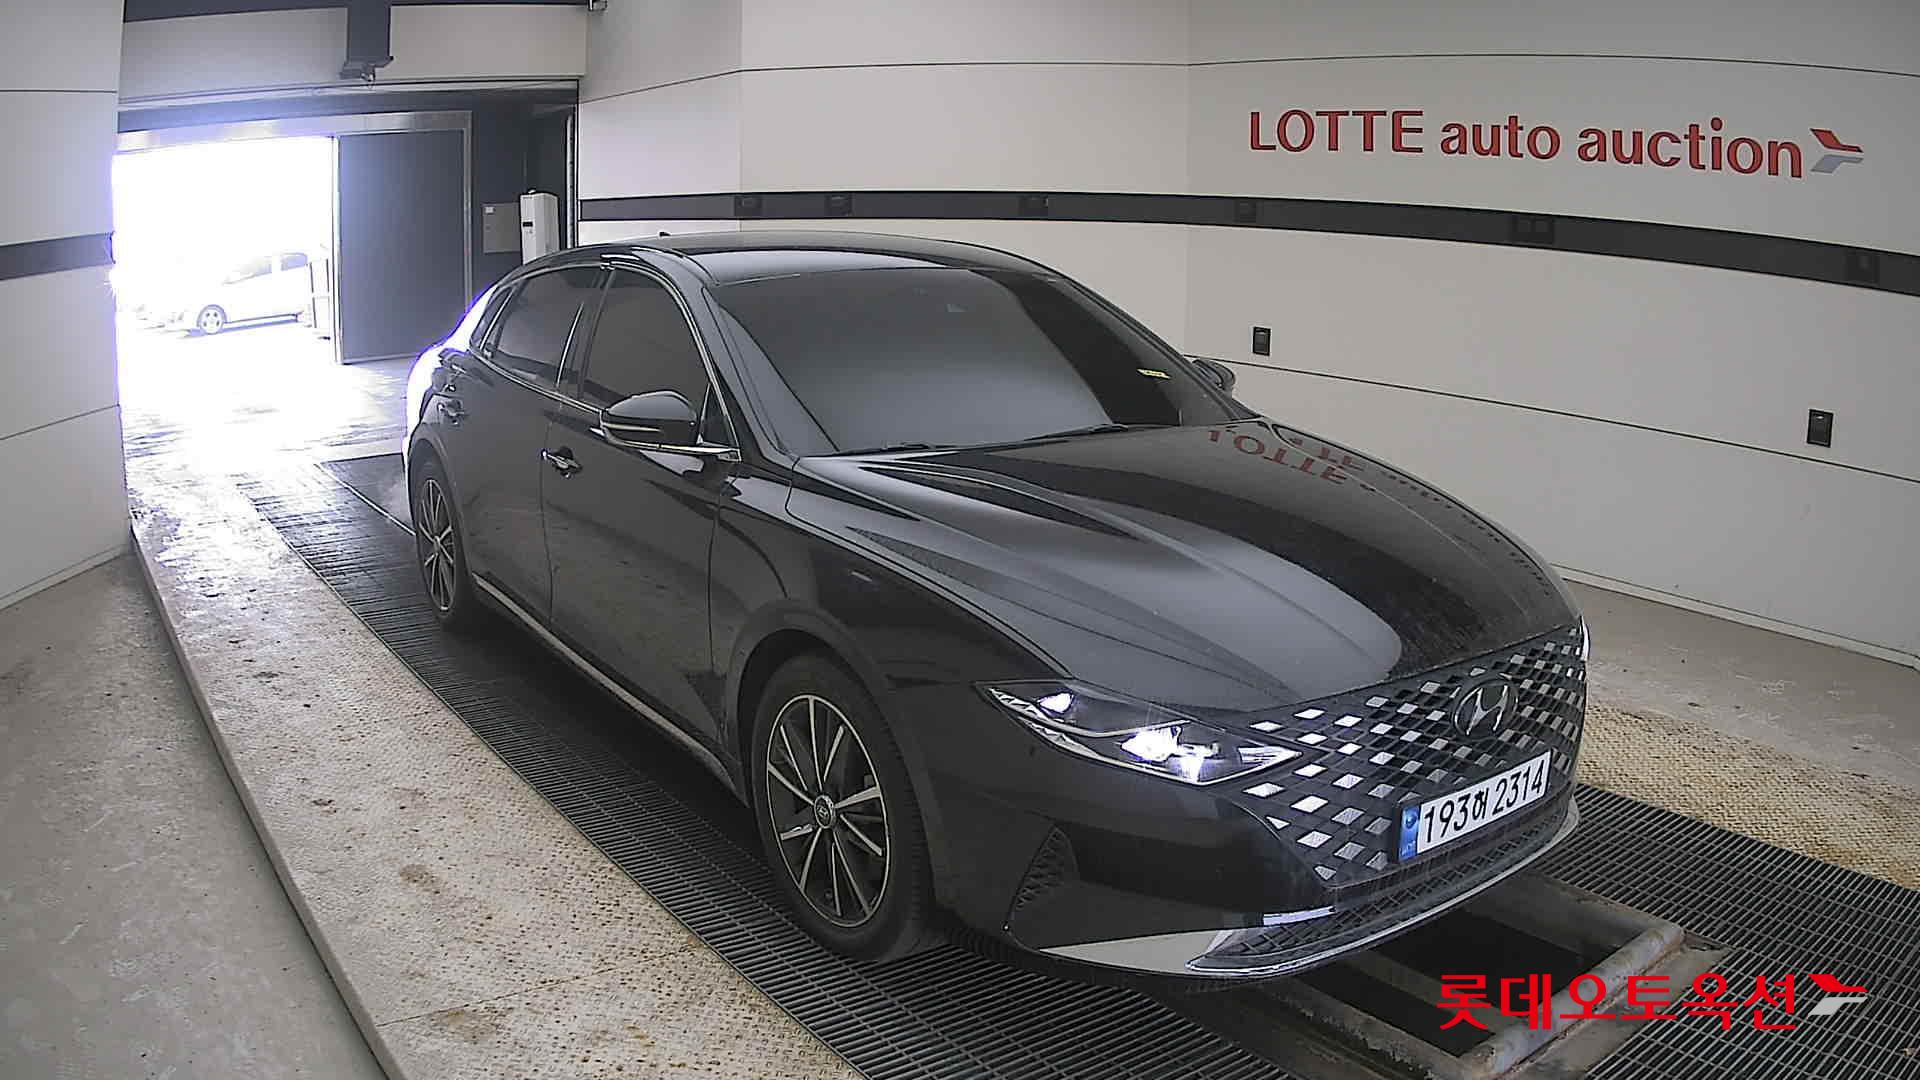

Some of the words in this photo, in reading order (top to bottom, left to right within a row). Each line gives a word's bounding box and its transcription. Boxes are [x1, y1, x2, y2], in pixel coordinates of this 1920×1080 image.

[1249, 110, 1424, 154] LOTTE
[1440, 114, 1562, 160] auto
[1576, 116, 1804, 178] auction
[1424, 787, 1489, 843] 193허
[1492, 759, 1545, 816] 2314
